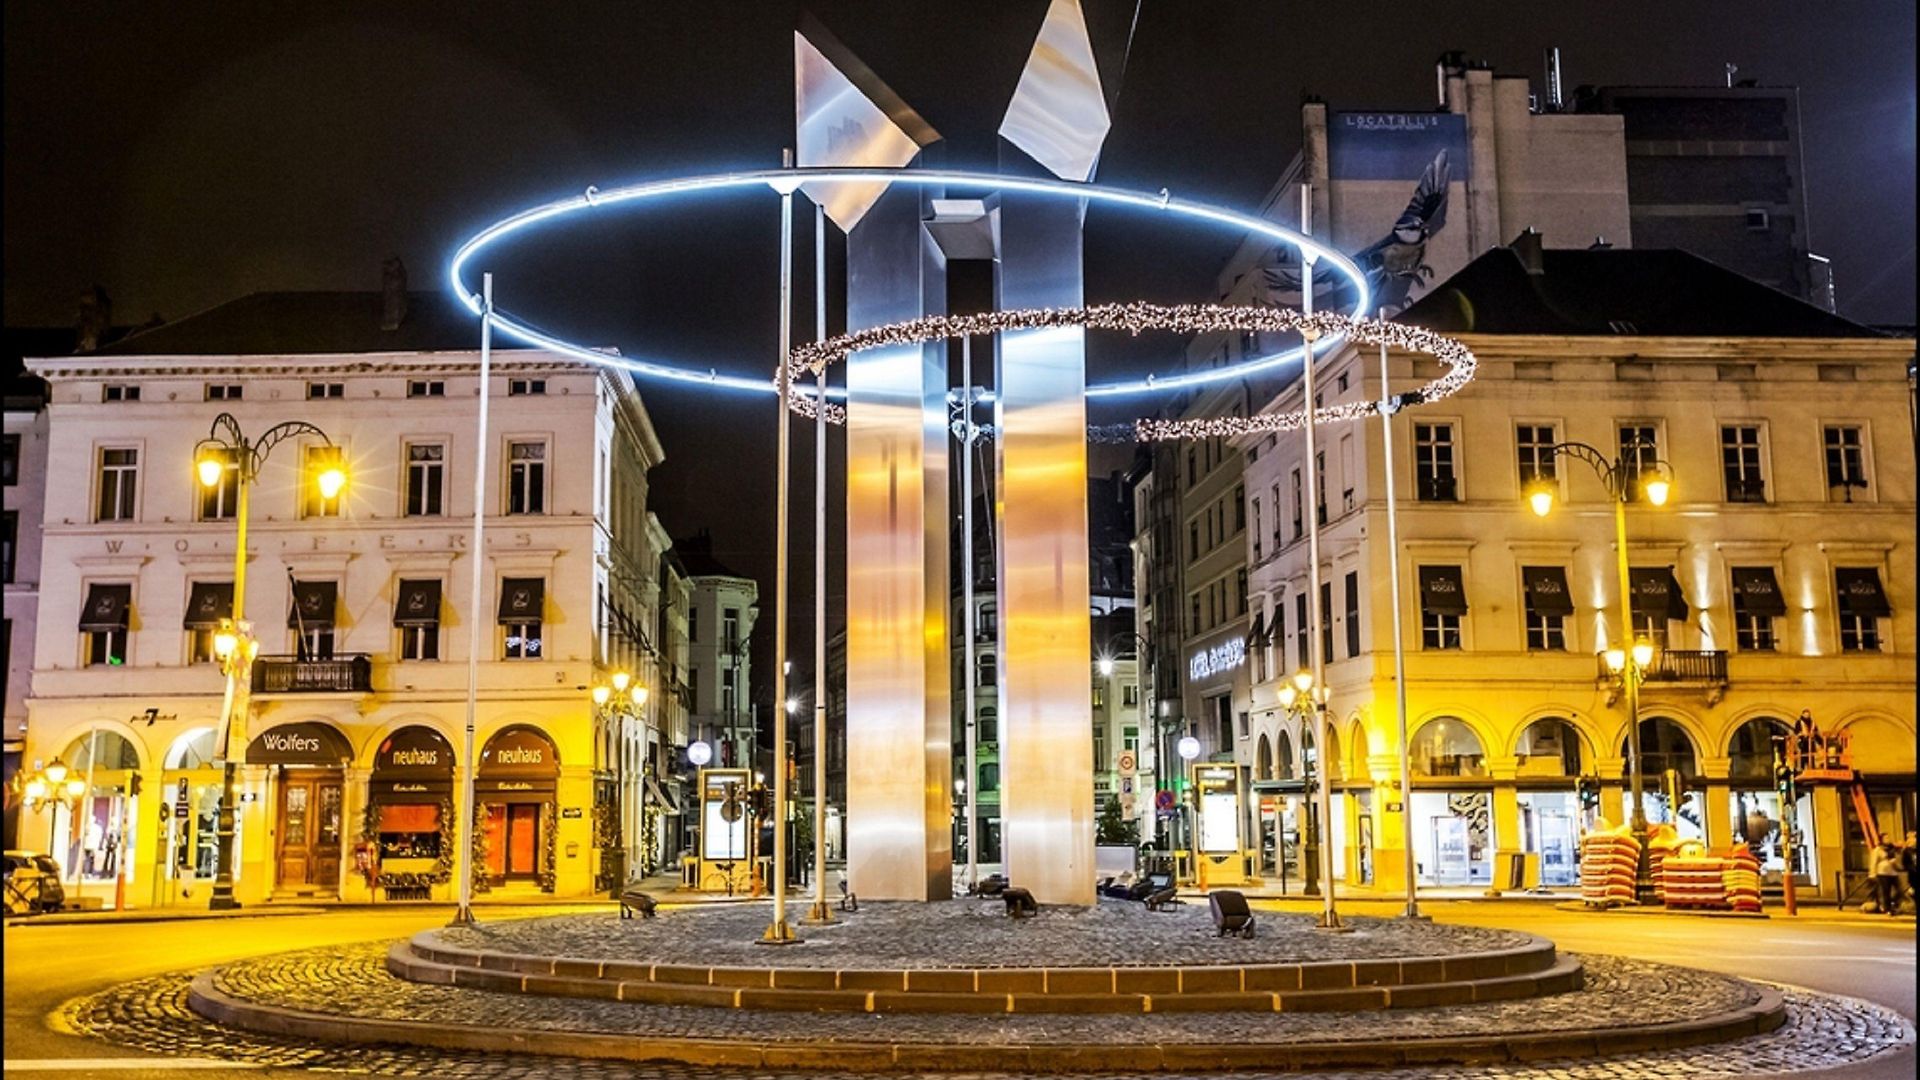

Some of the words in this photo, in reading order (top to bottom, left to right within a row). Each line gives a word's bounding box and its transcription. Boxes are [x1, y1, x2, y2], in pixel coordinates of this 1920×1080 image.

[263, 733, 320, 752] Wolfers
[393, 747, 438, 765] neuhaus
[497, 746, 542, 763] neuhaus
